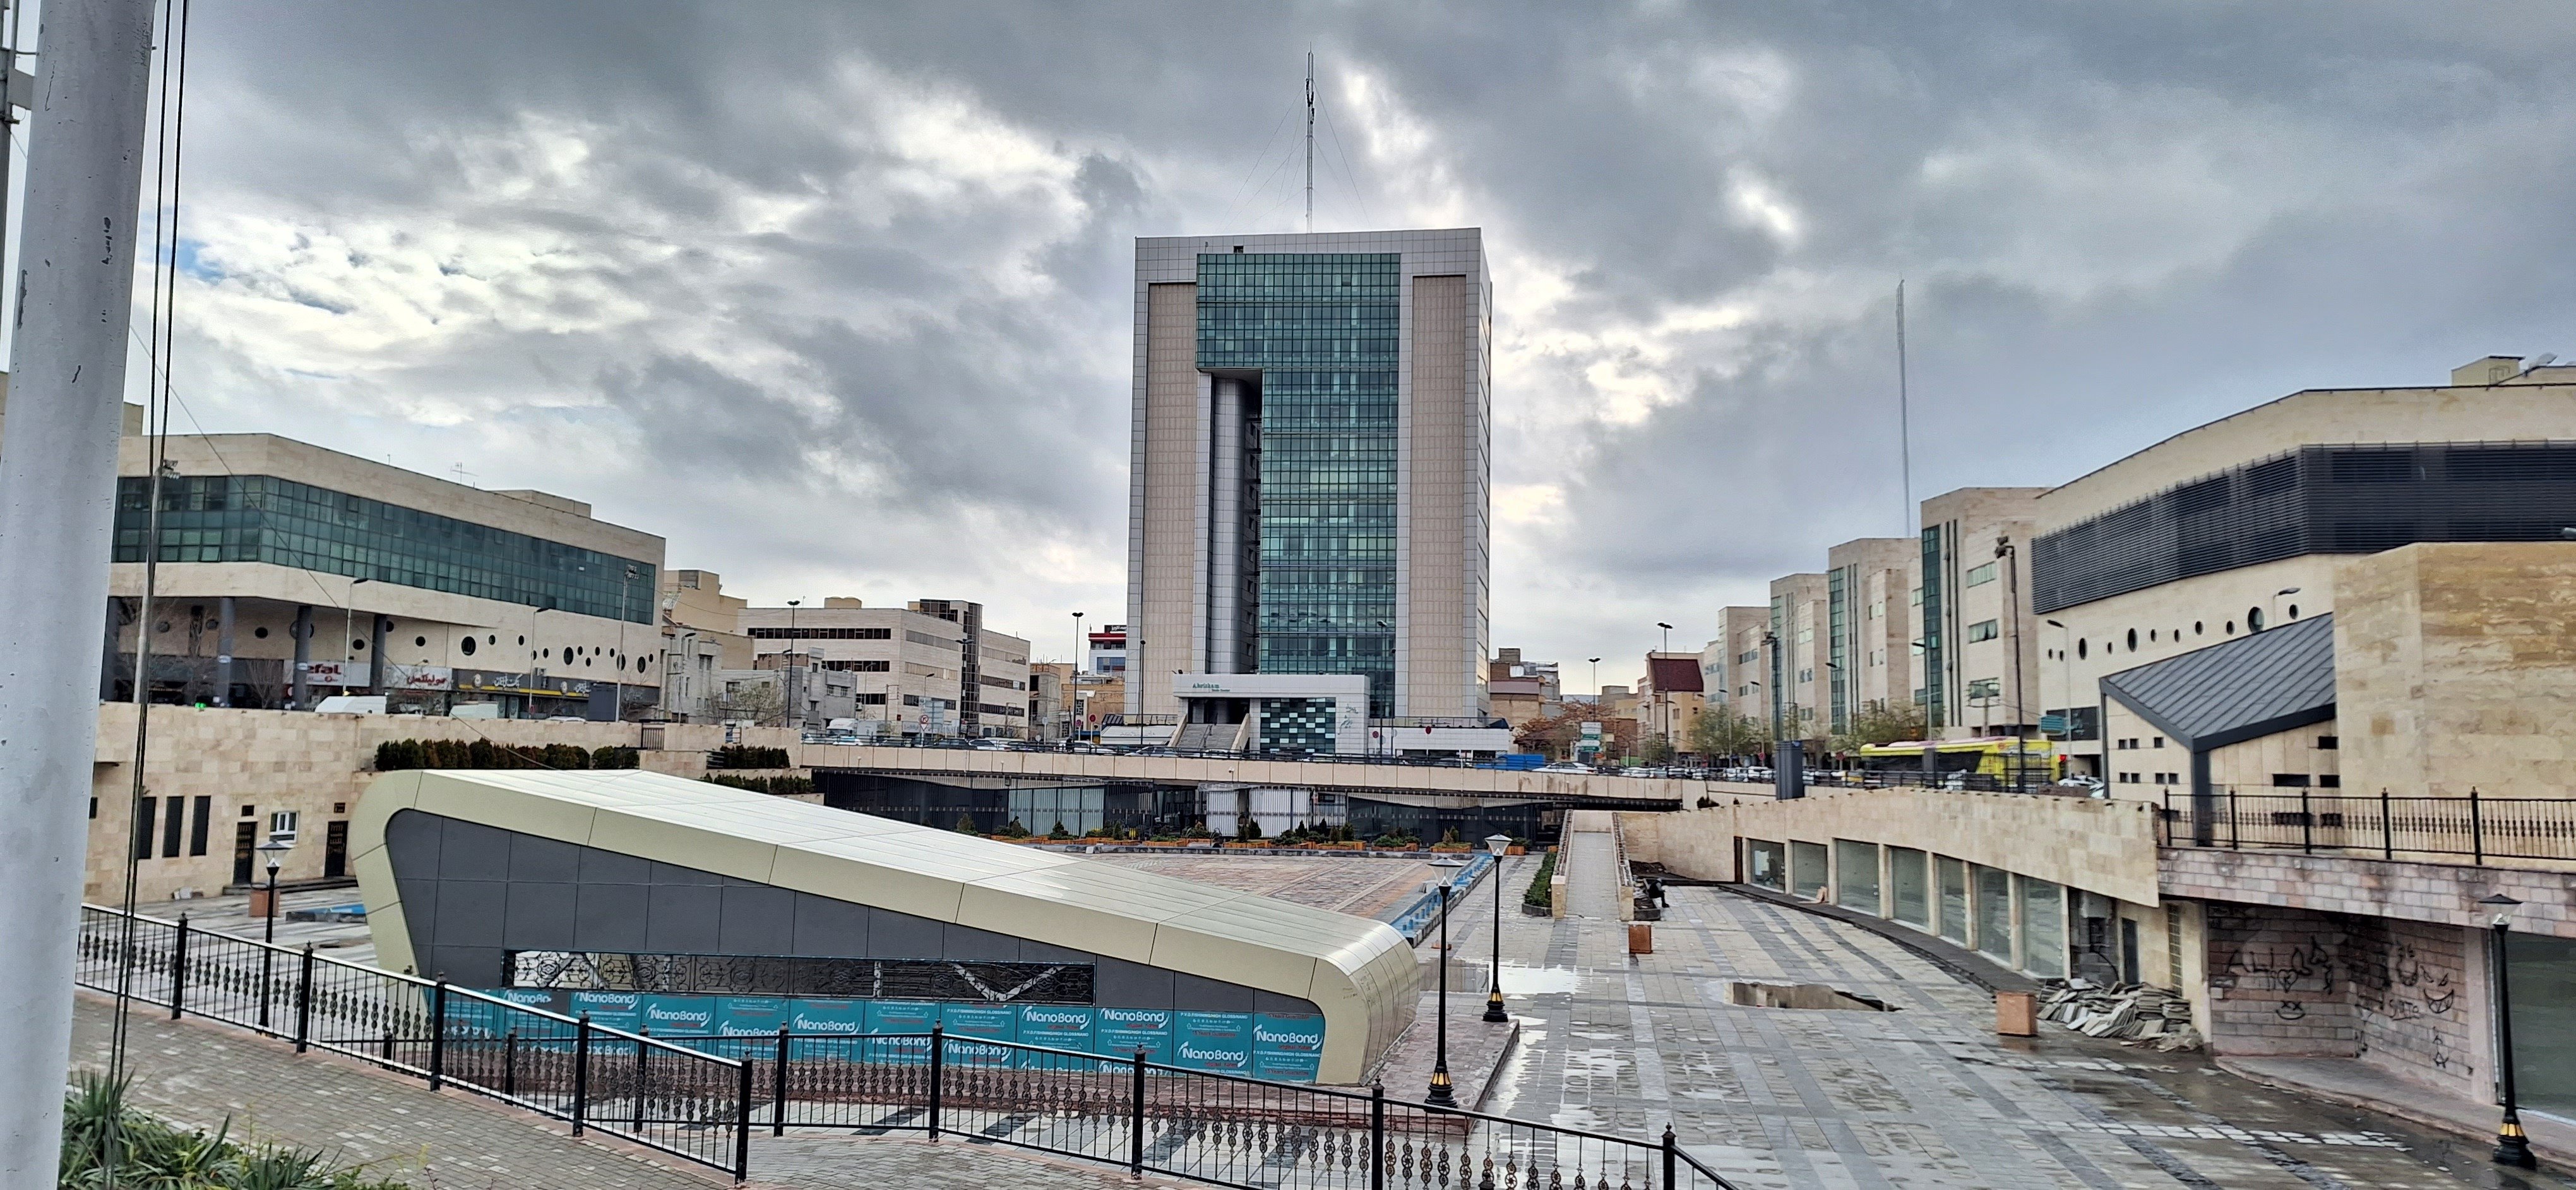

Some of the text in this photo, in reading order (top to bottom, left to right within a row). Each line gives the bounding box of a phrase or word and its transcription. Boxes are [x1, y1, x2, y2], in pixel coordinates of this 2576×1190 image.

[305, 663, 342, 675] efal
[508, 992, 551, 1004] NanoBo
[579, 992, 635, 1004] NanoBond
[650, 1009, 707, 1021] NanoBond
[1026, 1011, 1085, 1024] NanoBond
[1104, 1009, 1164, 1023] NanoBond
[797, 1019, 856, 1031] NanoBond
[1256, 1030, 1318, 1044] NanoBond
[948, 1043, 1007, 1055] NanoBond
[1183, 1048, 1244, 1061] NanoBond
